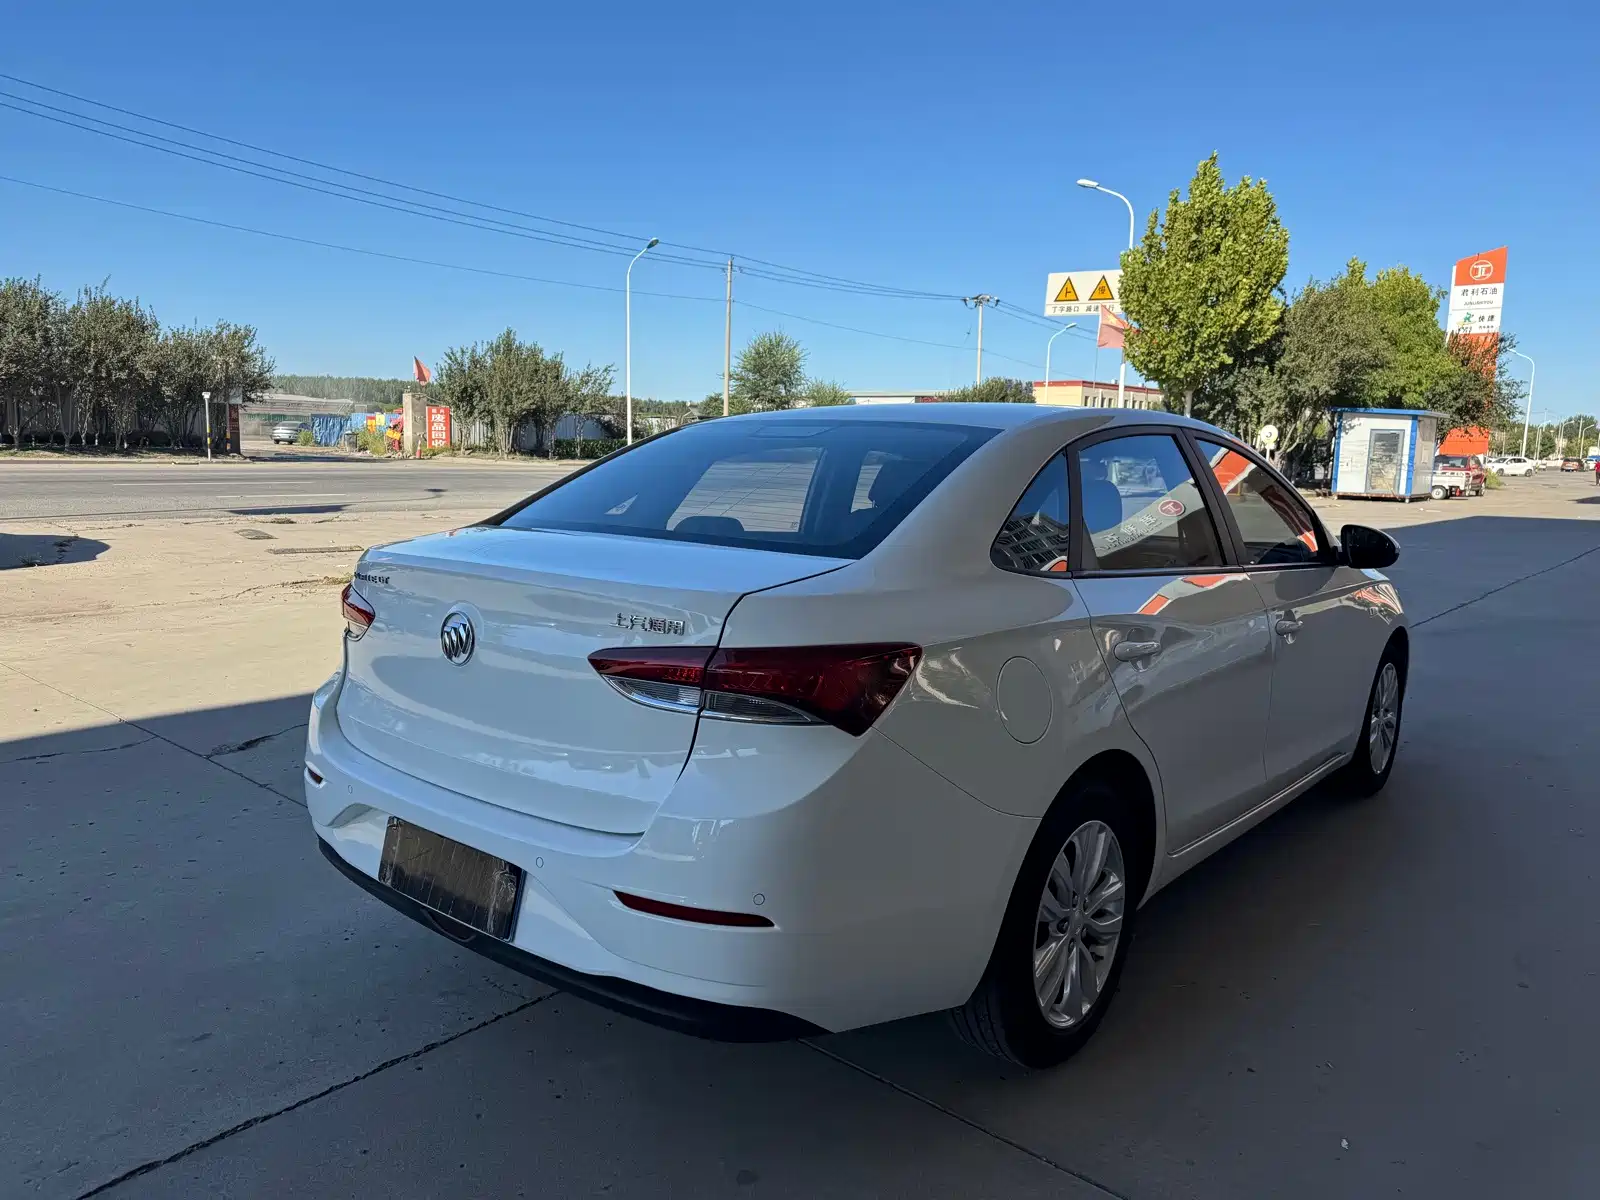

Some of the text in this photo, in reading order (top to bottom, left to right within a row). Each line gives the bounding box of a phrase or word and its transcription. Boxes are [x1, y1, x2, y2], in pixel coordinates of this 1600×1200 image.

[1052, 305, 1079, 313] 丁字路口
[609, 612, 686, 636] 上汽通用
